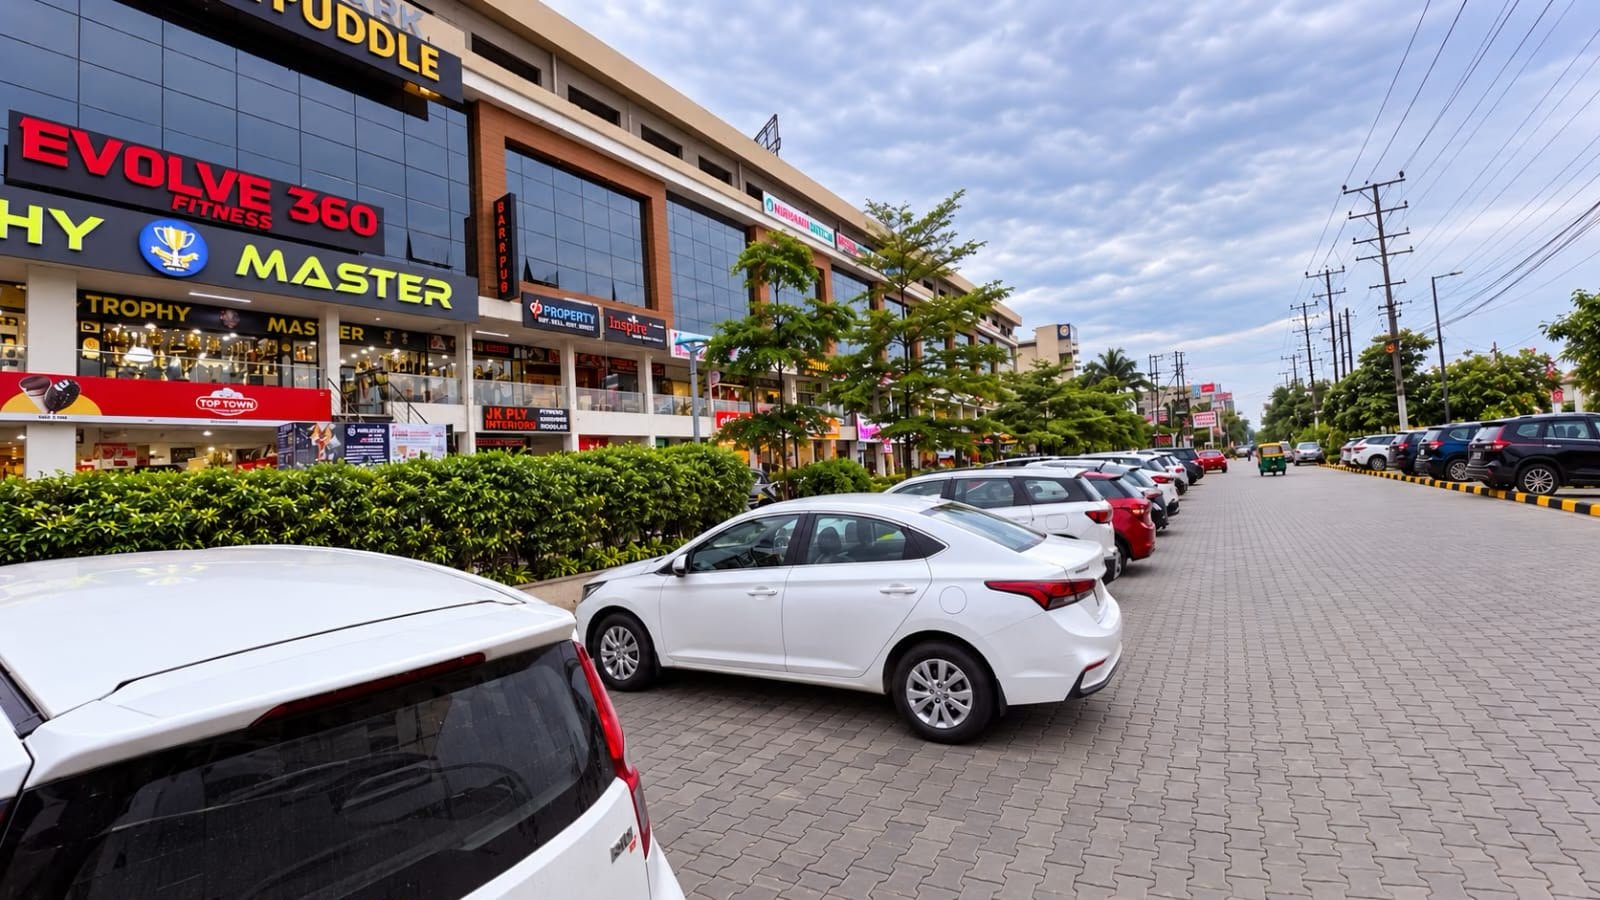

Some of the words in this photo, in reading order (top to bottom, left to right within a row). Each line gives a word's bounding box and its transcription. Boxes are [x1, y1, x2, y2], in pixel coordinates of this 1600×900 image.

[19, 116, 272, 211] EVOLVE
[287, 186, 378, 238] 360
[171, 195, 273, 230] FITNESS
[0, 199, 104, 251] HY
[235, 243, 453, 310] MASTER
[85, 294, 192, 322] TROPHY
[267, 317, 364, 341] MASER
[544, 305, 595, 324] PROPERTY
[608, 316, 647, 336] Inspire
[200, 400, 221, 408] TOP
[223, 401, 254, 409] TOWN
[486, 407, 502, 420] JK
[506, 407, 528, 420] PLY
